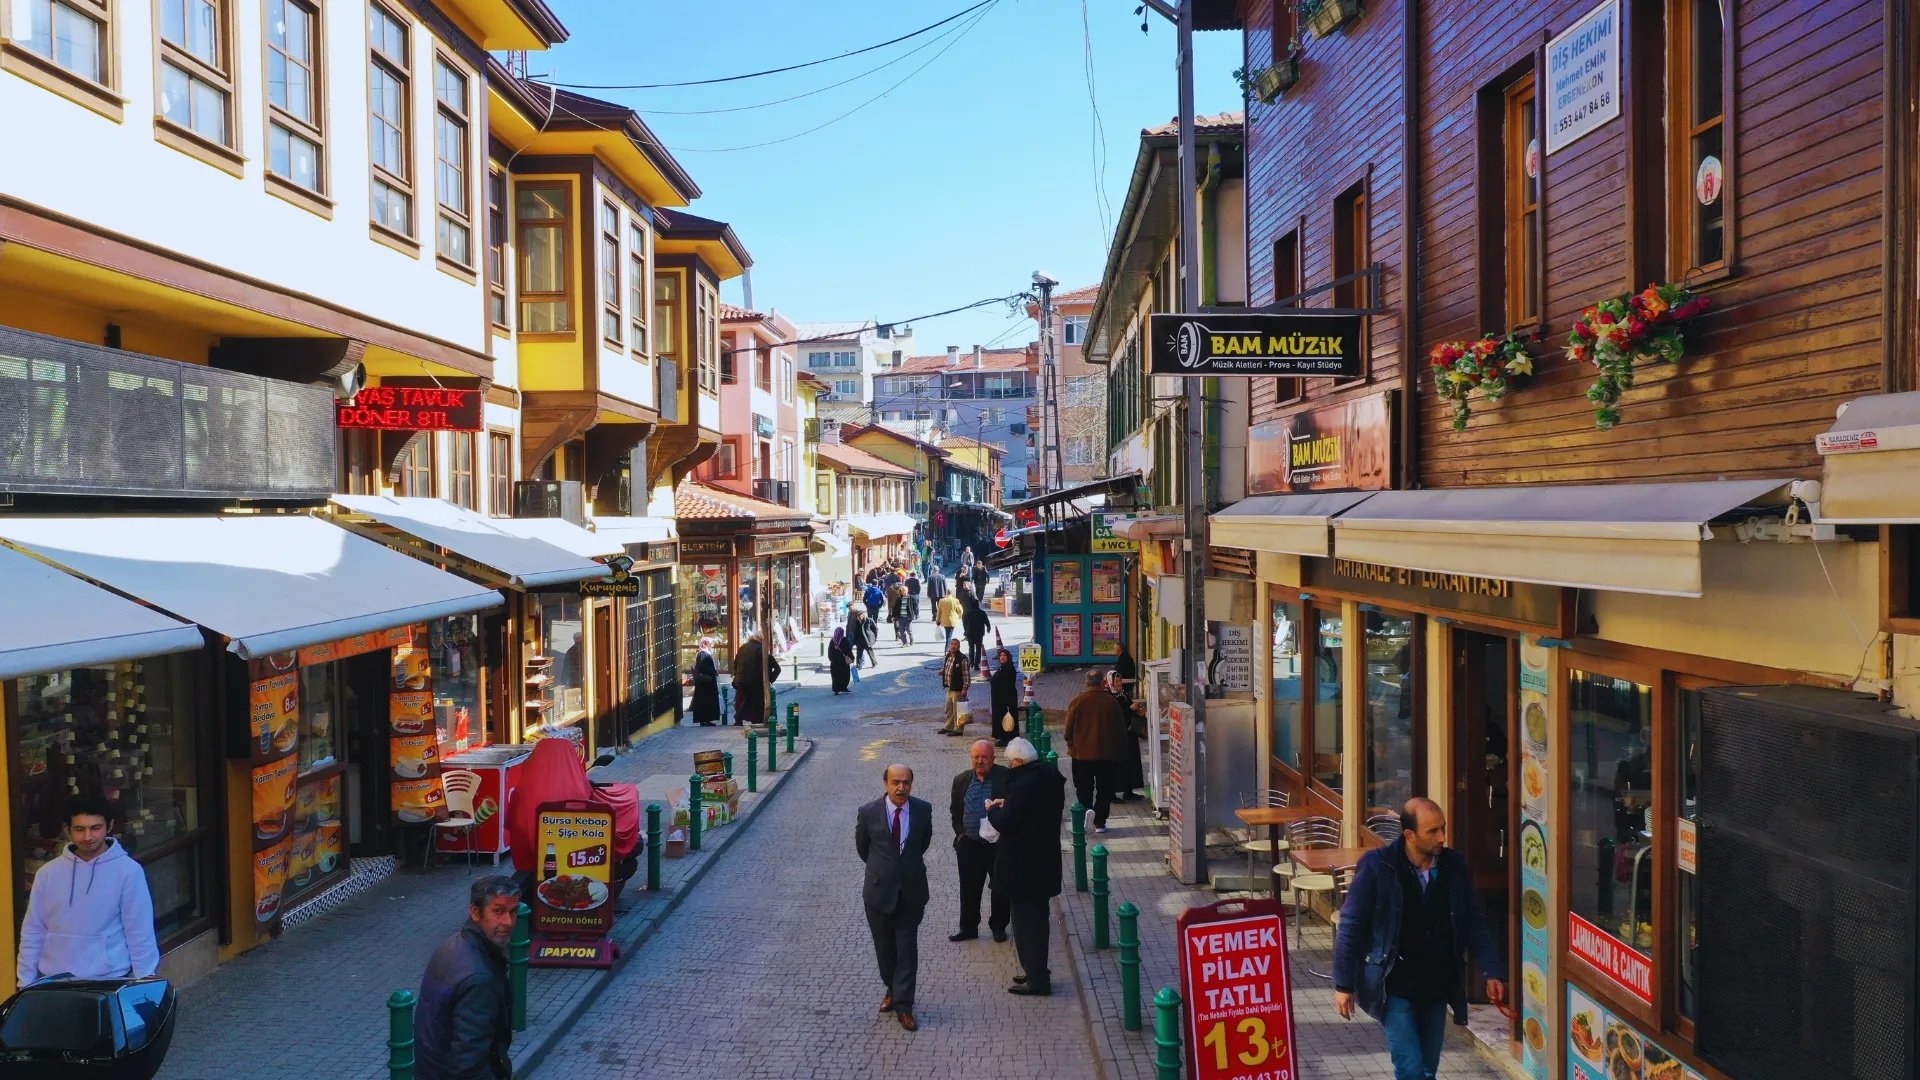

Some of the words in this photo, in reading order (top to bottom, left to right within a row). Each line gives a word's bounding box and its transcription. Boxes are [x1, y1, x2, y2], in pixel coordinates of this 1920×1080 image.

[1552, 47, 1569, 73] DİŞ
[1571, 10, 1612, 60] HEKİMİ
[1556, 65, 1583, 93] Mehmet
[1585, 49, 1606, 73] EMİN
[1558, 70, 1604, 110] ERGENEKON
[1560, 114, 1572, 132] 553
[1574, 105, 1587, 122] 447
[1589, 101, 1598, 114] 84
[1600, 91, 1610, 108] 68
[1211, 336, 1263, 355] BAM
[1212, 360, 1234, 368] Müzik
[1236, 360, 1263, 368] Aletleri
[1317, 361, 1342, 370] Stüdyo
[401, 390, 464, 408] TAVUK
[340, 405, 412, 426] DÖNER
[1292, 442, 1310, 466] BAM
[1096, 528, 1112, 538] ÇA
[1022, 659, 1038, 667] WC
[542, 816, 572, 826] Bursa
[575, 817, 608, 828] Kebap
[558, 828, 579, 838] Şişe
[582, 829, 605, 838] Kola
[542, 916, 573, 925] PAPYON
[576, 914, 603, 926] DÖNER
[1192, 927, 1278, 956] YEMEK
[1572, 920, 1612, 970] LAHMACUN
[1202, 955, 1271, 983] PİLAV
[1205, 982, 1272, 1010] TATLI
